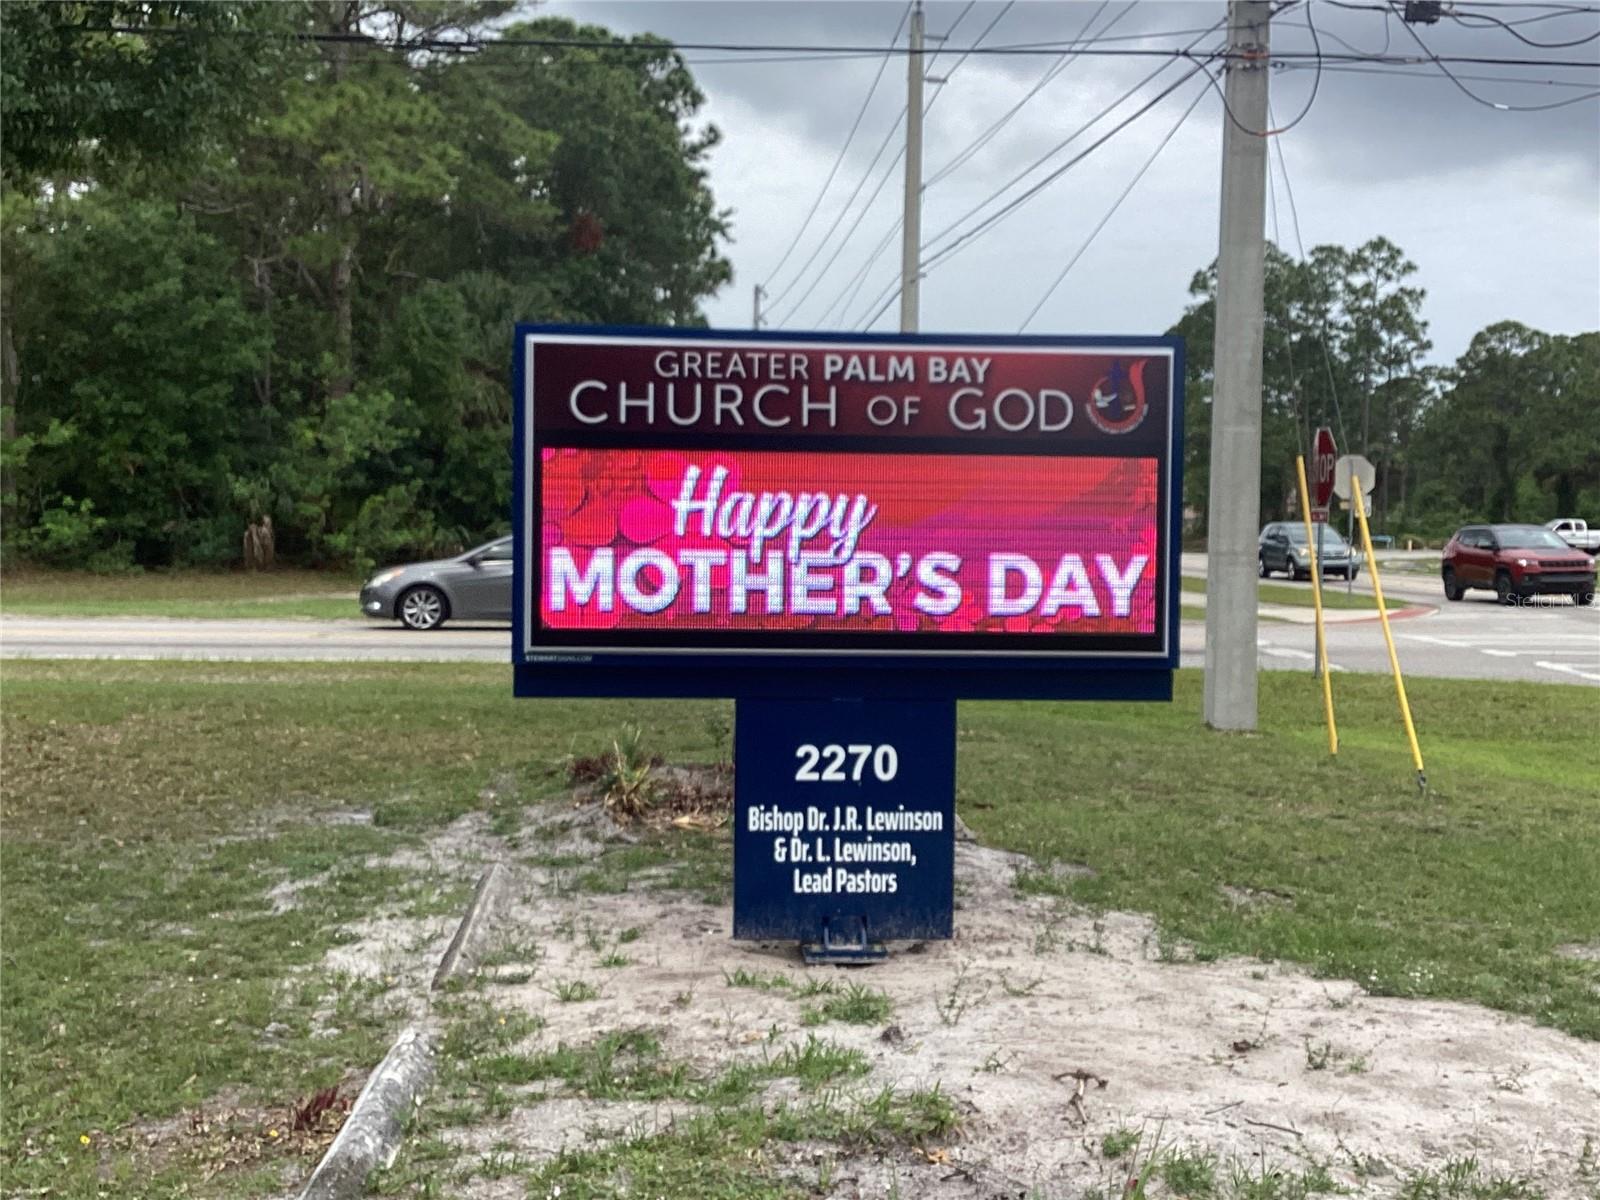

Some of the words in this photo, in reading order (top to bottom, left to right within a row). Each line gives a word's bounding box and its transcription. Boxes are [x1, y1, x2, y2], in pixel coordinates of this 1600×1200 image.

[655, 351, 809, 380] GREATER
[823, 354, 915, 382] PALM
[928, 357, 992, 383] BAY
[569, 379, 837, 427] CHURCH
[866, 395, 921, 426] OF
[948, 387, 1074, 432] GOD
[671, 464, 878, 566] Happy
[549, 546, 964, 616] MOTHER'S
[988, 552, 1148, 617] DAY
[795, 744, 898, 781] 2270
[748, 805, 804, 836] Bishop
[807, 807, 830, 831] Dr.
[833, 807, 863, 831] J.R.
[866, 805, 943, 832] Lewinson
[774, 837, 788, 862] &
[790, 838, 813, 862] Dr.
[816, 838, 831, 862] L.
[834, 835, 917, 866] Lewinson,
[794, 866, 832, 893] Lead
[836, 868, 898, 893] Pastors
